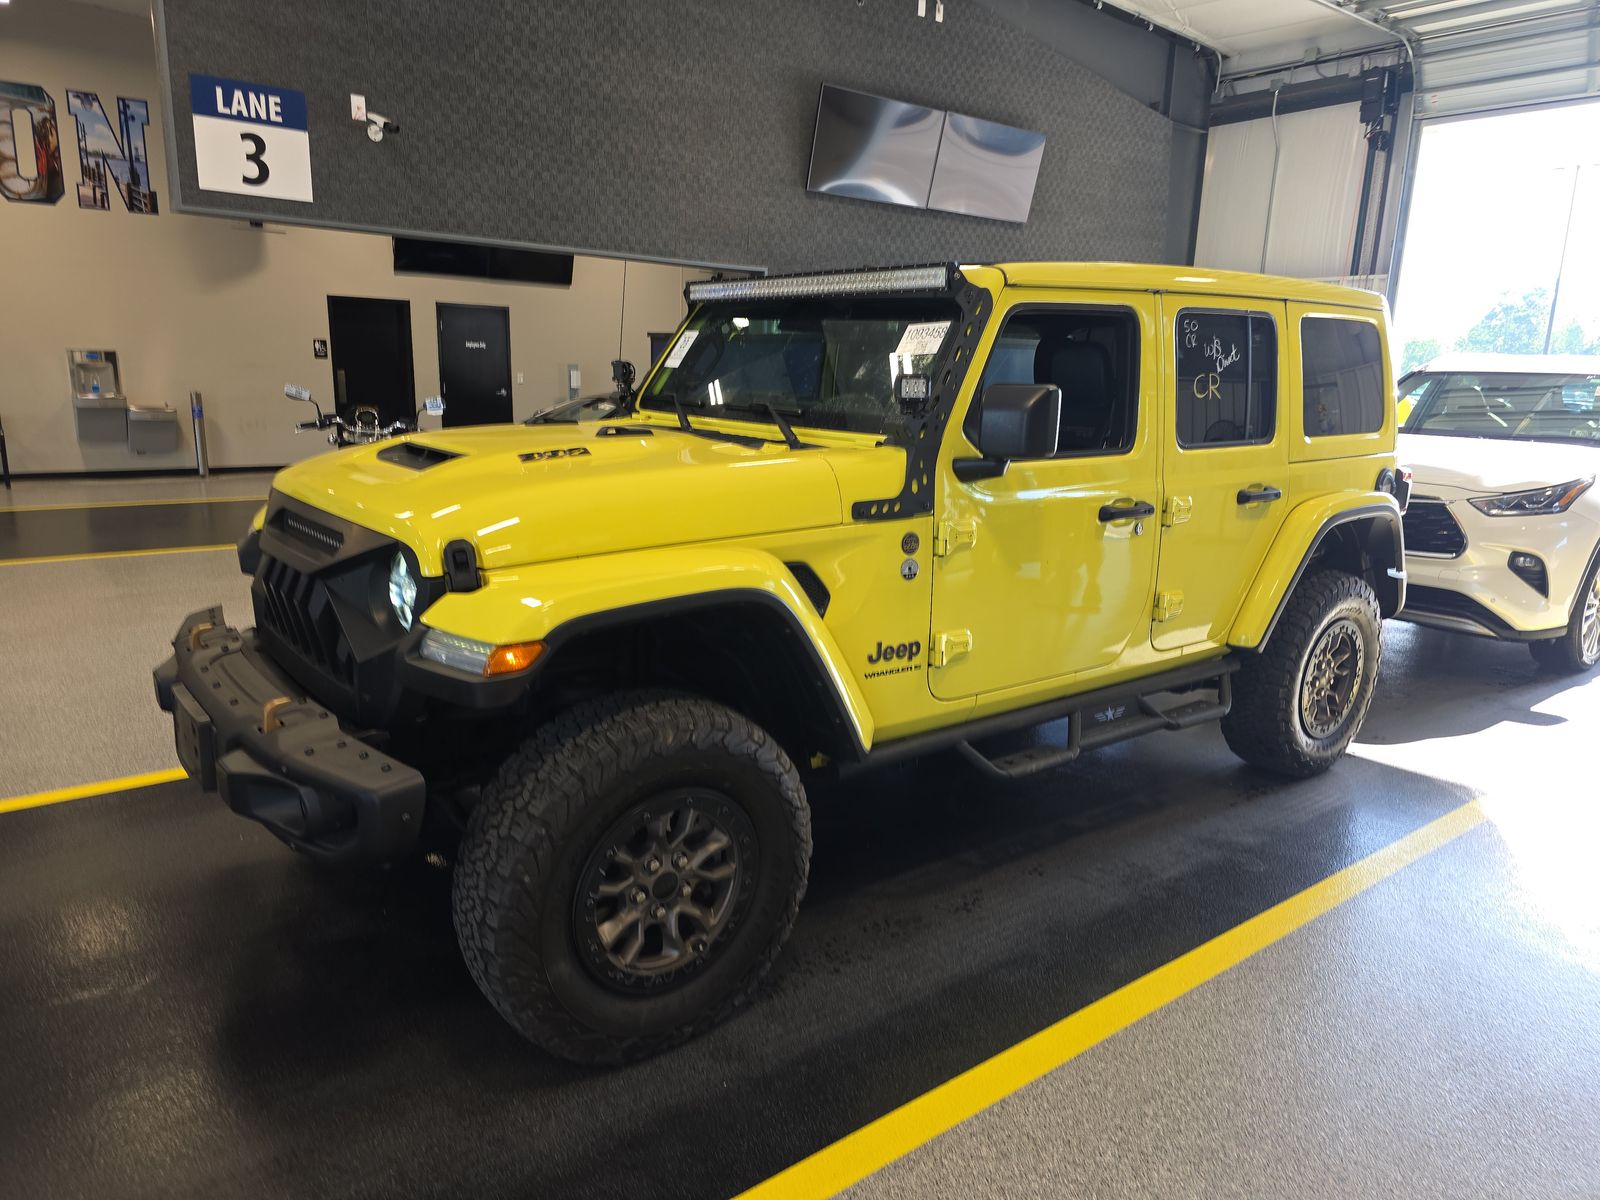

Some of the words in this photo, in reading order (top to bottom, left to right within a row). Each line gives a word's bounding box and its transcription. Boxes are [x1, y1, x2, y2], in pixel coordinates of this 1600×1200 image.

[215, 85, 283, 123] LANE
[240, 132, 270, 187] 3
[1194, 373, 1221, 400] CR
[867, 640, 921, 665] Jeep
